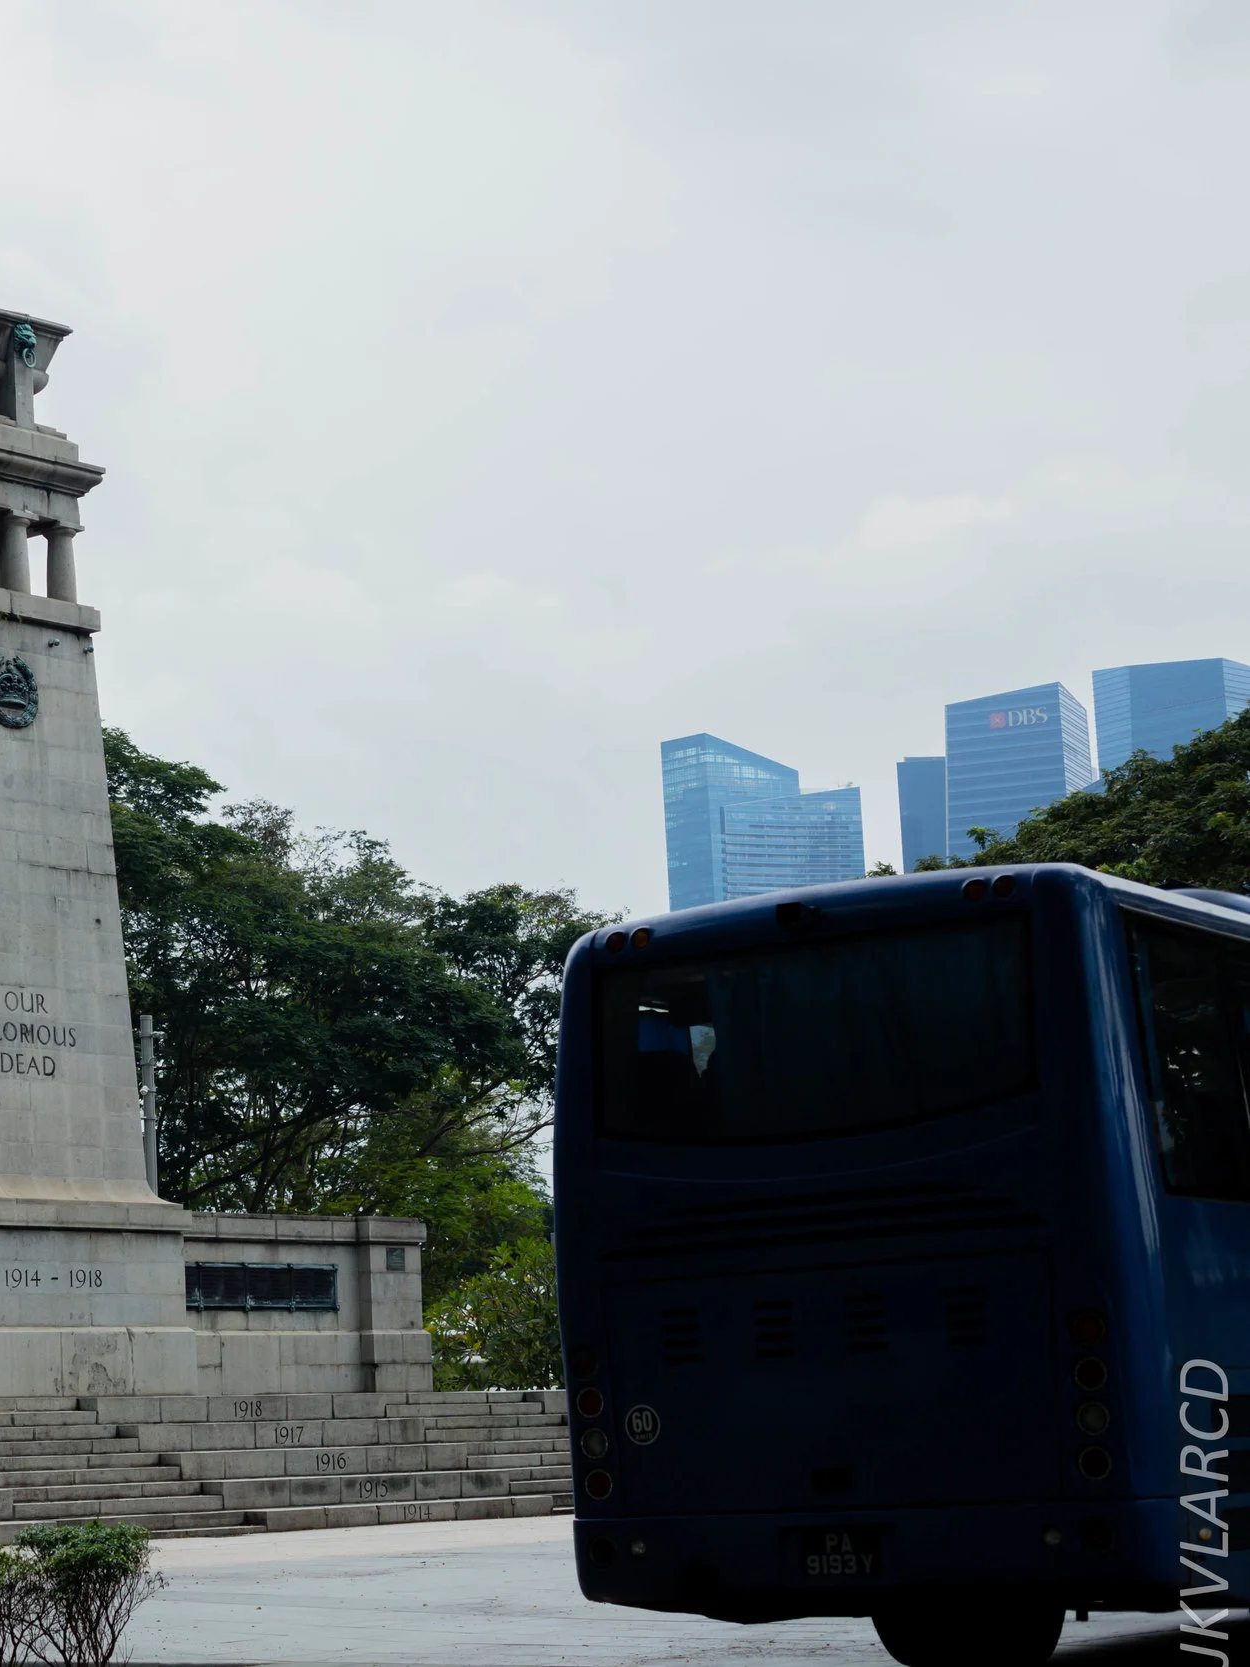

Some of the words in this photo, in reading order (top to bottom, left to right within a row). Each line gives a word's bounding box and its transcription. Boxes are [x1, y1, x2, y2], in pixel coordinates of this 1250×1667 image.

[1008, 707, 1048, 726] DBS
[4, 991, 48, 1014] OUR
[0, 1052, 56, 1076] DEAD
[4, 1268, 41, 1289] 1914
[69, 1268, 103, 1289] 1918
[234, 1400, 262, 1418] 1918
[632, 1410, 653, 1433] 60
[274, 1426, 304, 1445] 1917
[316, 1452, 347, 1471] 1916
[358, 1480, 388, 1499] 1915
[403, 1504, 432, 1520] 1914
[825, 1532, 853, 1553] PA
